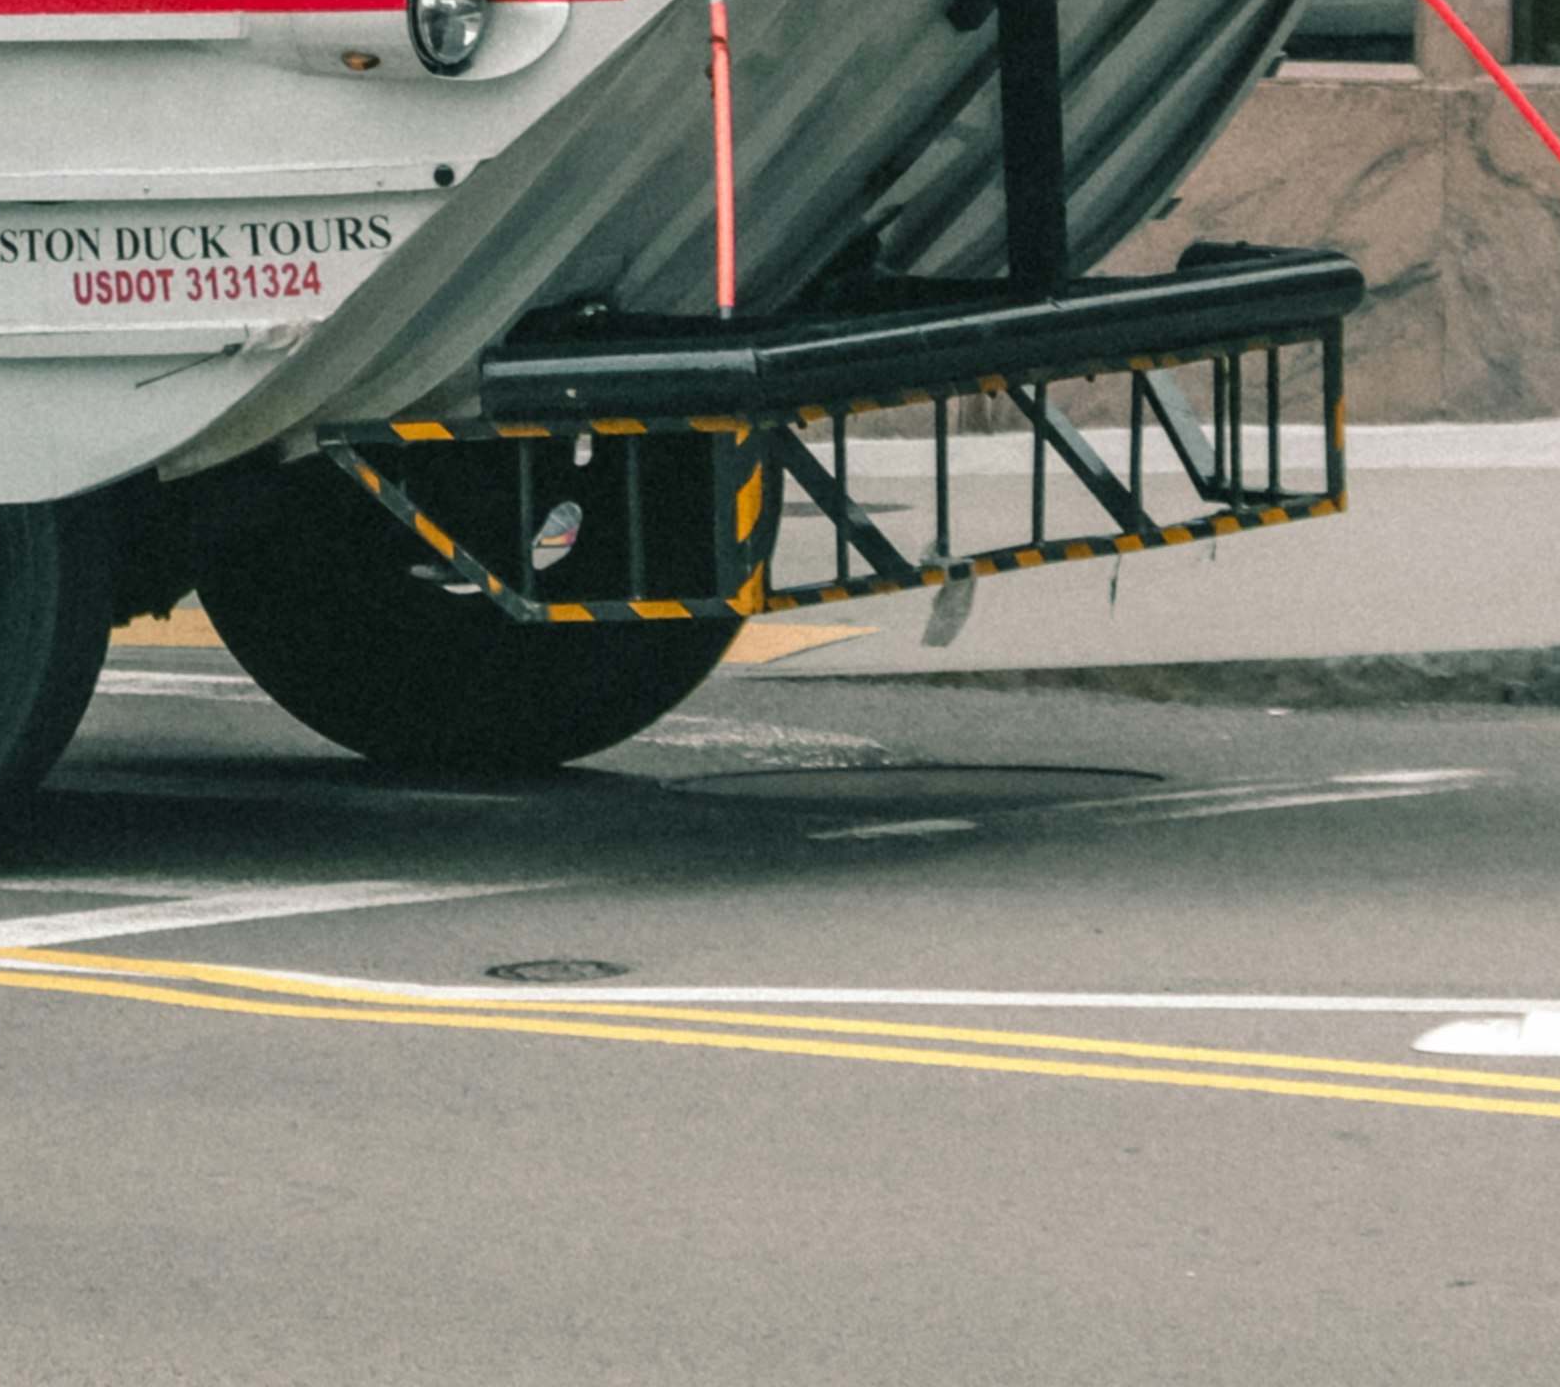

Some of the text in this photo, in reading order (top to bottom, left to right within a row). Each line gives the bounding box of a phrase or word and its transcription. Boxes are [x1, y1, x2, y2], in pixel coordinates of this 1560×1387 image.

[115, 224, 228, 261] DUCK
[239, 214, 393, 257] TOURS
[73, 261, 322, 305] USDOT 3131324
